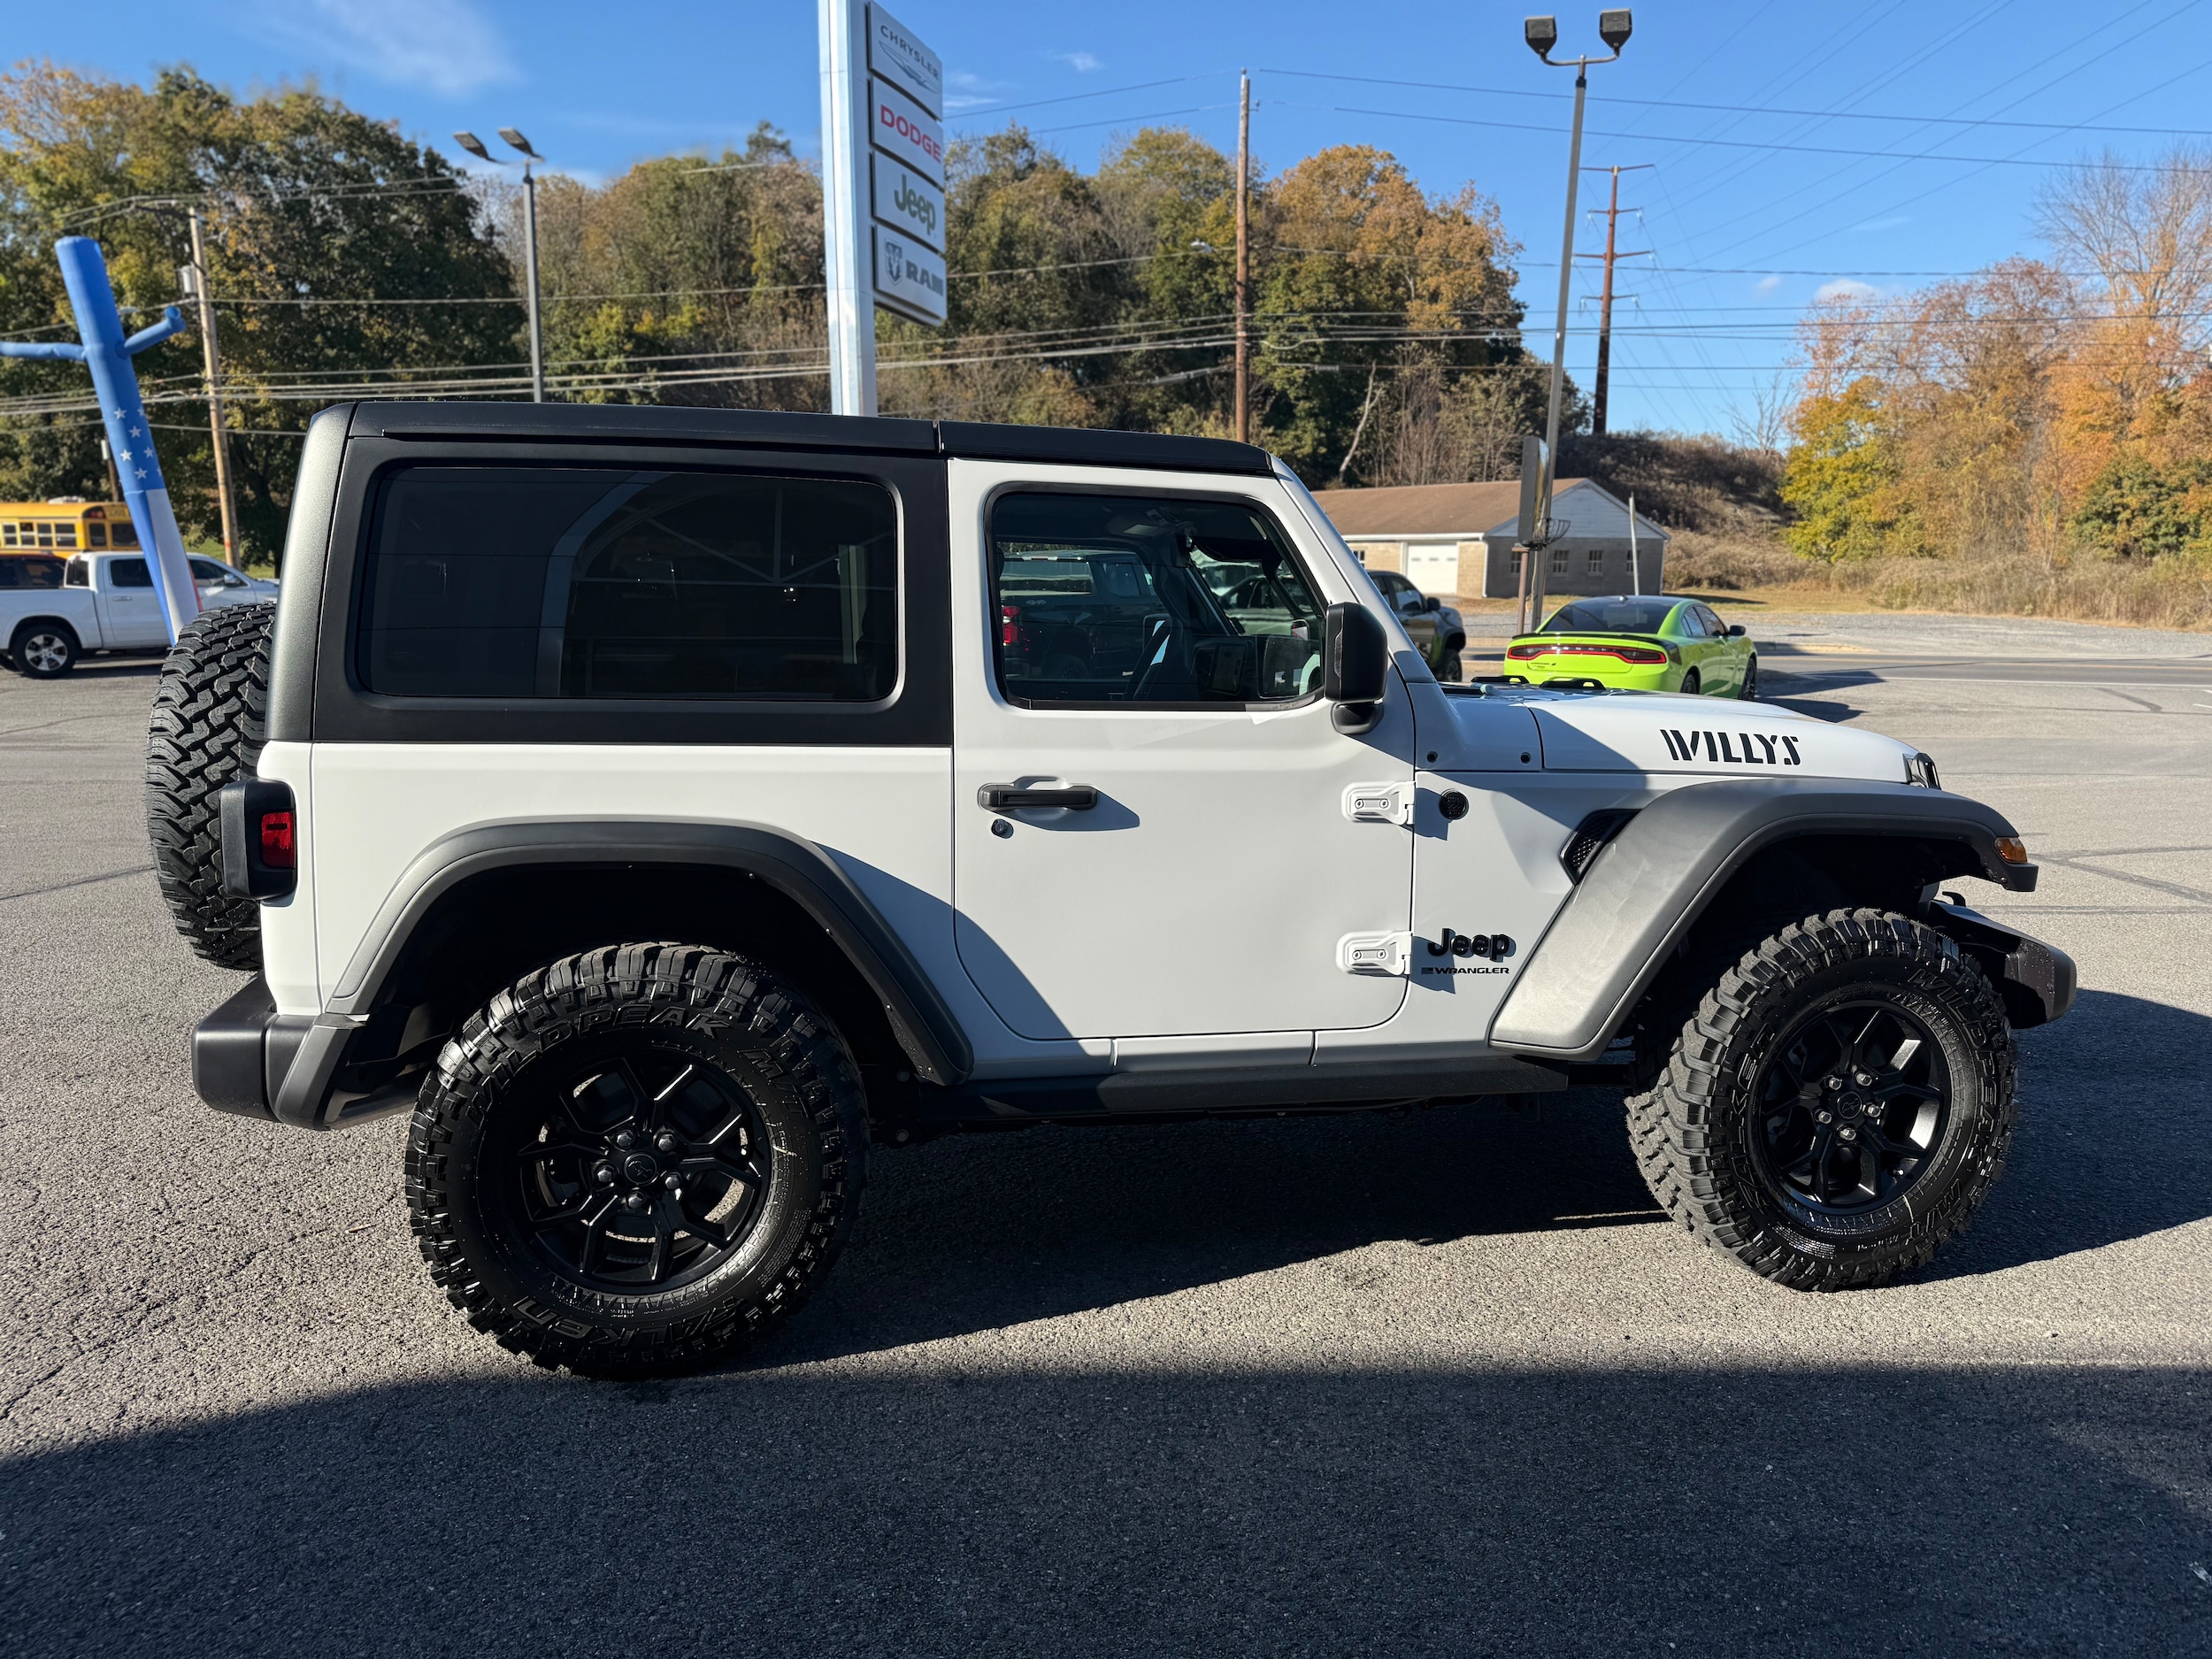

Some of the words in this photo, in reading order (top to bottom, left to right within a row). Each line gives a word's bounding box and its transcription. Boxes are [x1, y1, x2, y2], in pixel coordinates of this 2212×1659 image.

[879, 25, 939, 81] CHRYSLER
[879, 104, 941, 164] DODGE
[894, 173, 936, 235] Jeep
[905, 259, 944, 297] RAM
[1659, 729, 1801, 766] WILLYS
[1427, 928, 1509, 962] Jeep
